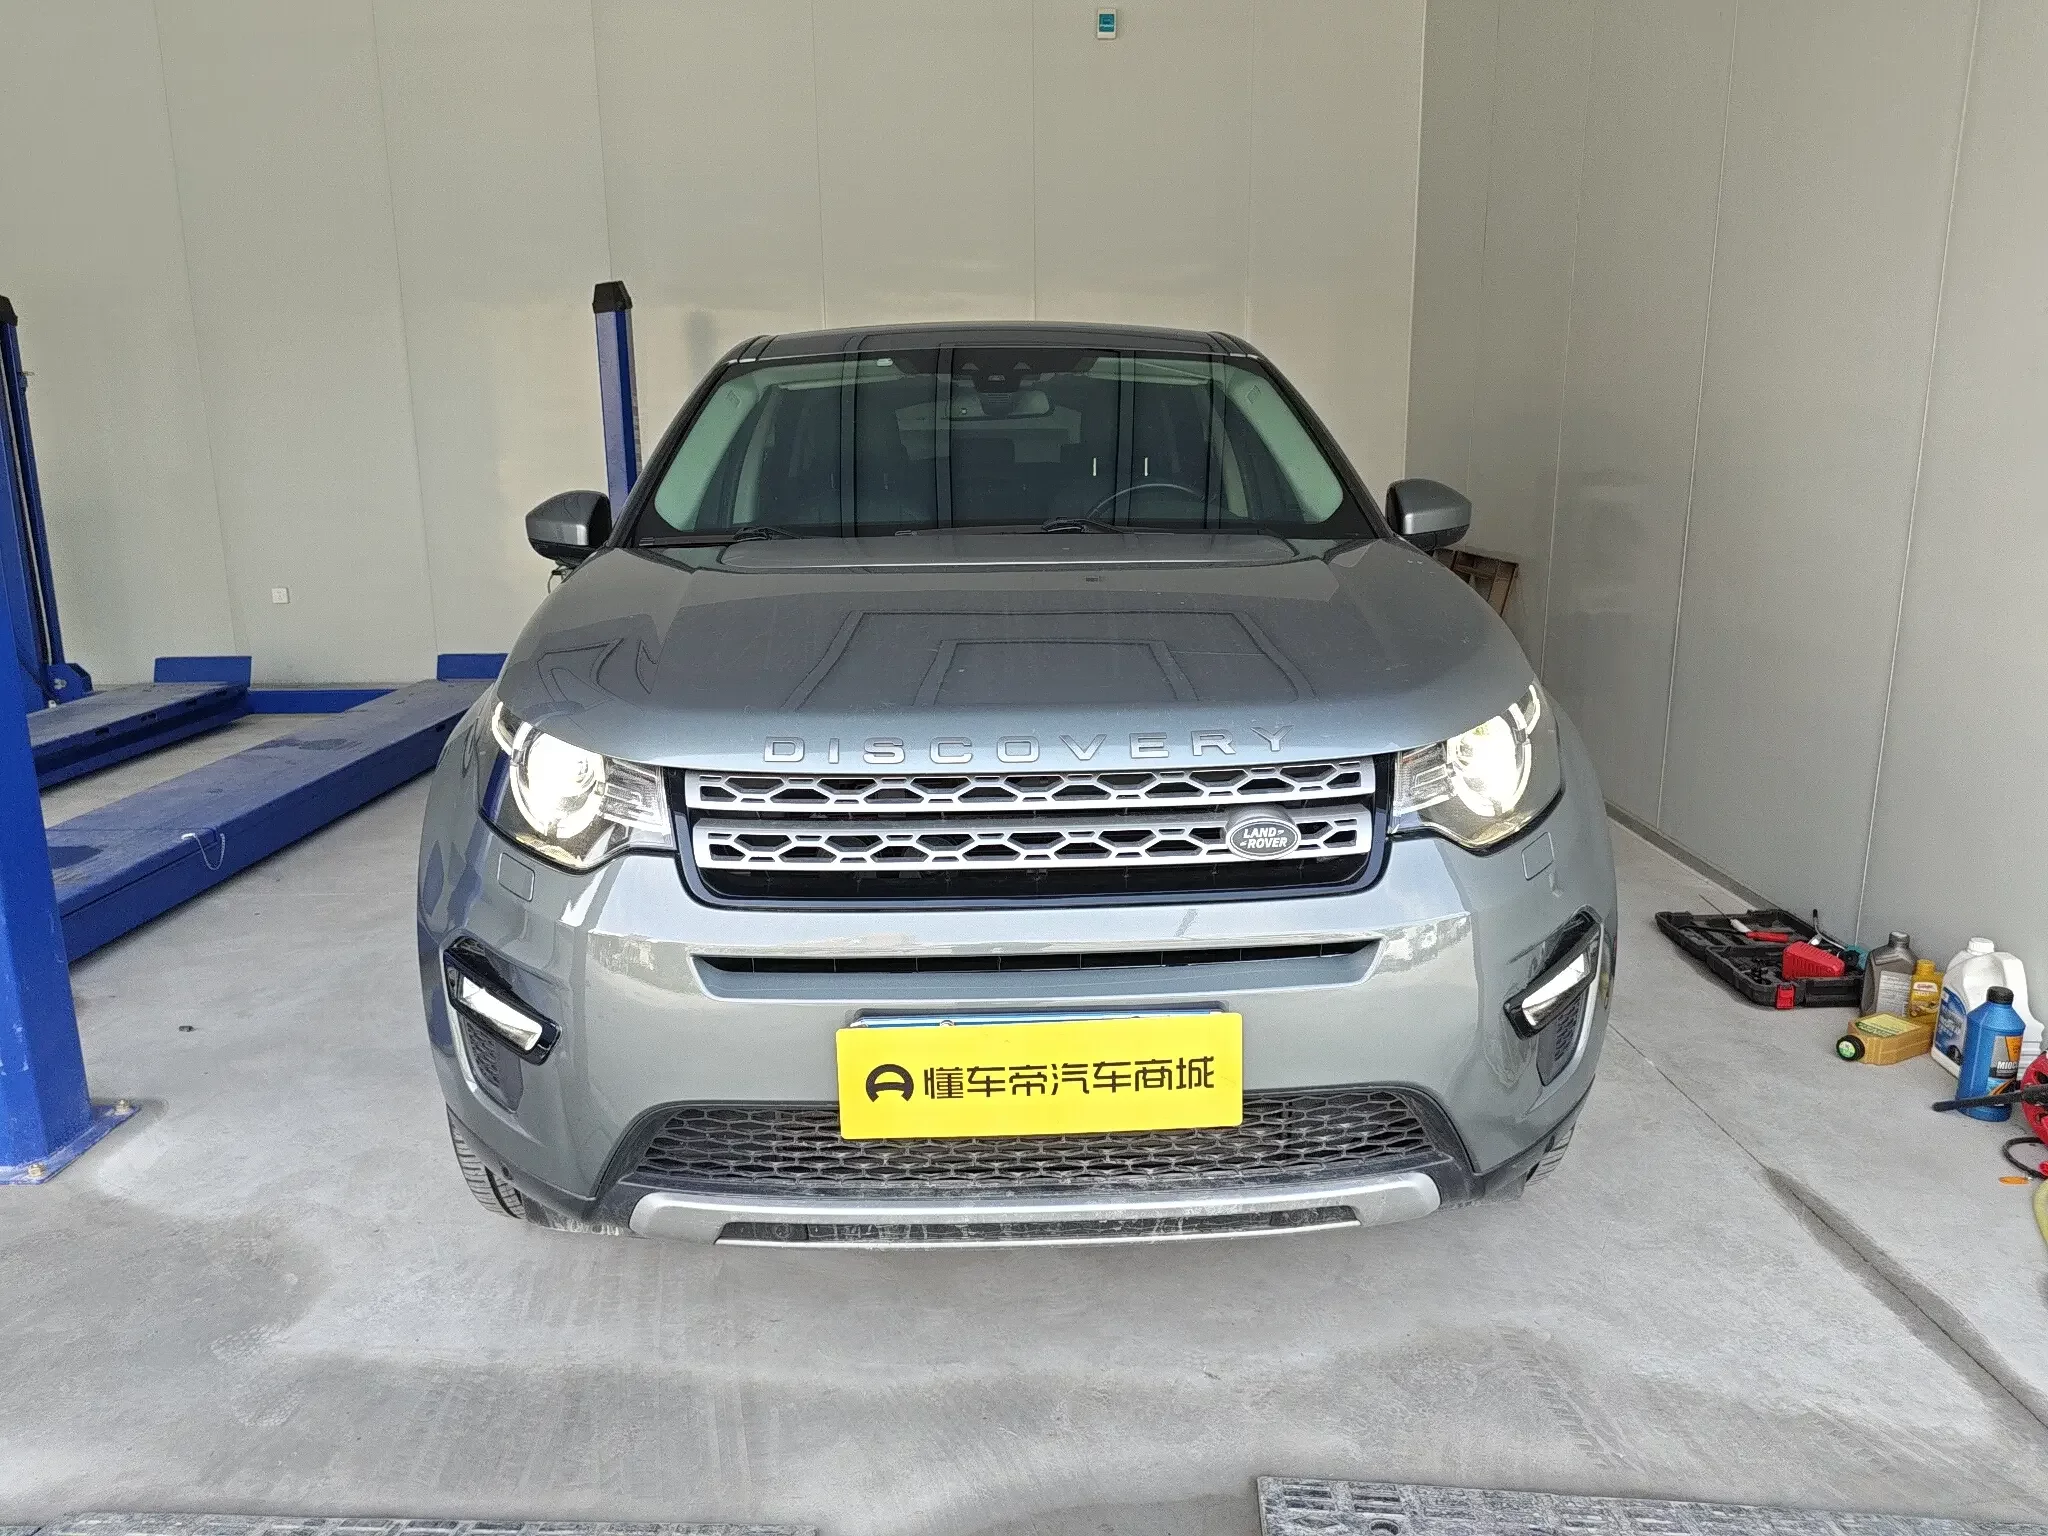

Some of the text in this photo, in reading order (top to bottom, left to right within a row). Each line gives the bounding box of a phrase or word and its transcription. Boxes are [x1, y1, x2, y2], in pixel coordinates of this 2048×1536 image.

[764, 725, 1295, 765] DISCOVERY
[1243, 827, 1277, 839] LAND
[1247, 837, 1288, 849] ROVER
[923, 1055, 1215, 1100] 懂车帝汽车商城
